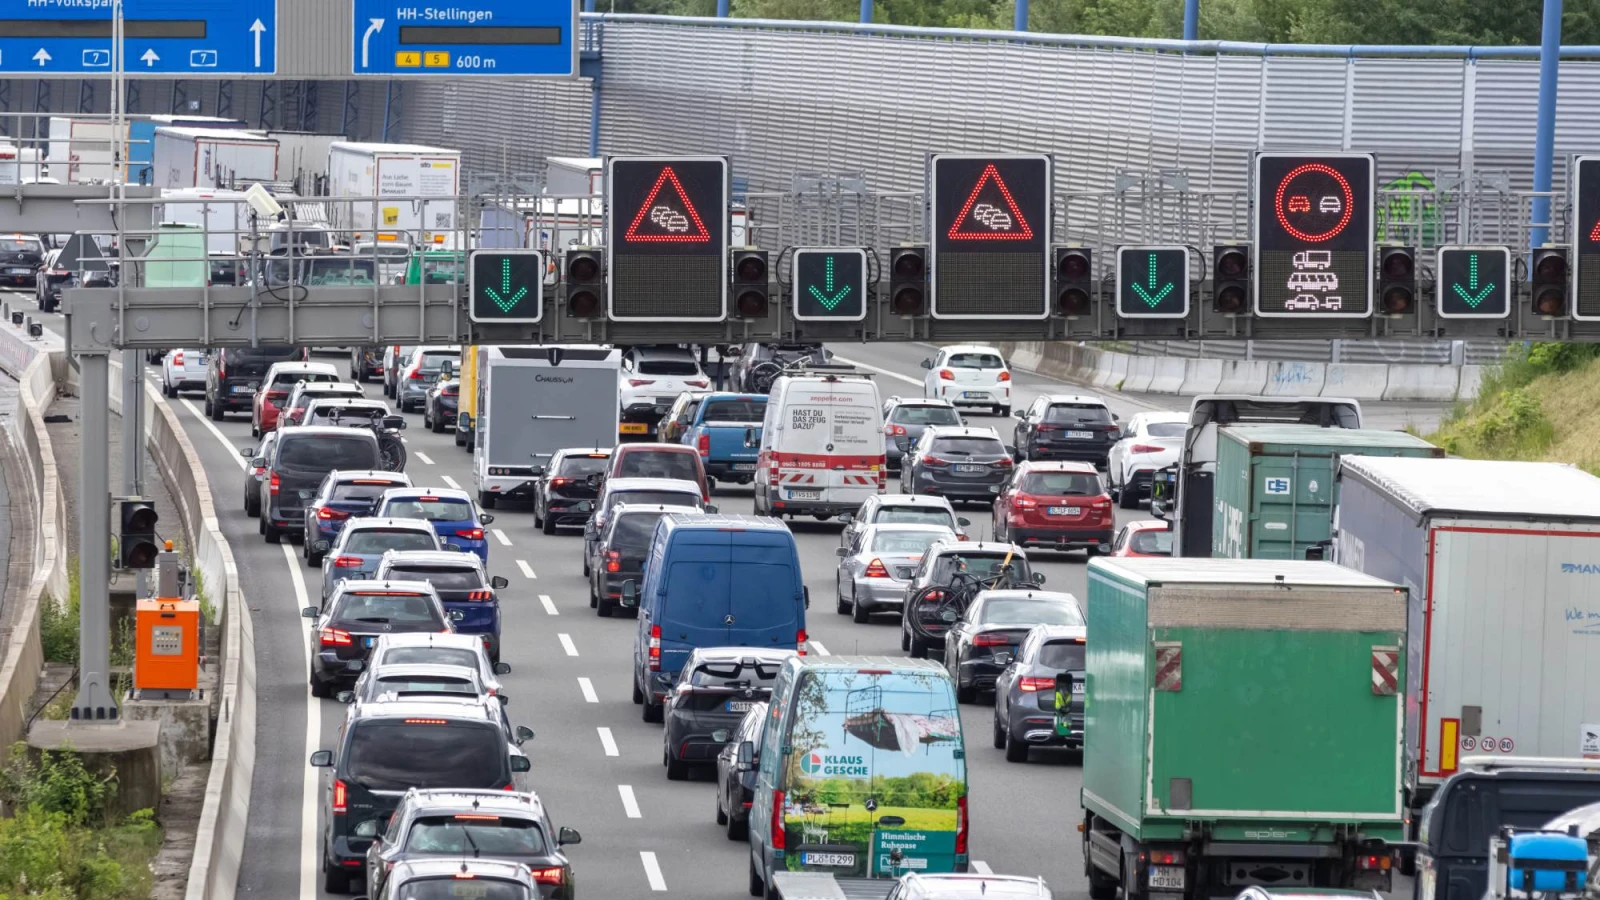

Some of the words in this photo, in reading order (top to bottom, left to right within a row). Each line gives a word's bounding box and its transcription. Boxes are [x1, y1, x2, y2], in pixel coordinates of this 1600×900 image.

[397, 8, 493, 23] HH-Stellingen
[93, 53, 99, 63] 7
[201, 53, 207, 63] 7
[405, 55, 412, 64] 4
[433, 55, 440, 64] 5
[456, 56, 481, 68] 600
[484, 59, 496, 68] m
[793, 409, 811, 417] HAST
[1565, 606, 1584, 621] We
[1464, 739, 1474, 748] 60
[1484, 740, 1494, 749] 70
[1501, 741, 1511, 750] 80
[824, 755, 863, 765] KLAUS
[824, 765, 868, 775] GESCHE
[881, 832, 926, 841] Himmlische
[1244, 827, 1297, 840] spier
[837, 855, 853, 865] 299
[1152, 876, 1165, 887] HD
[1166, 877, 1182, 888] 104
